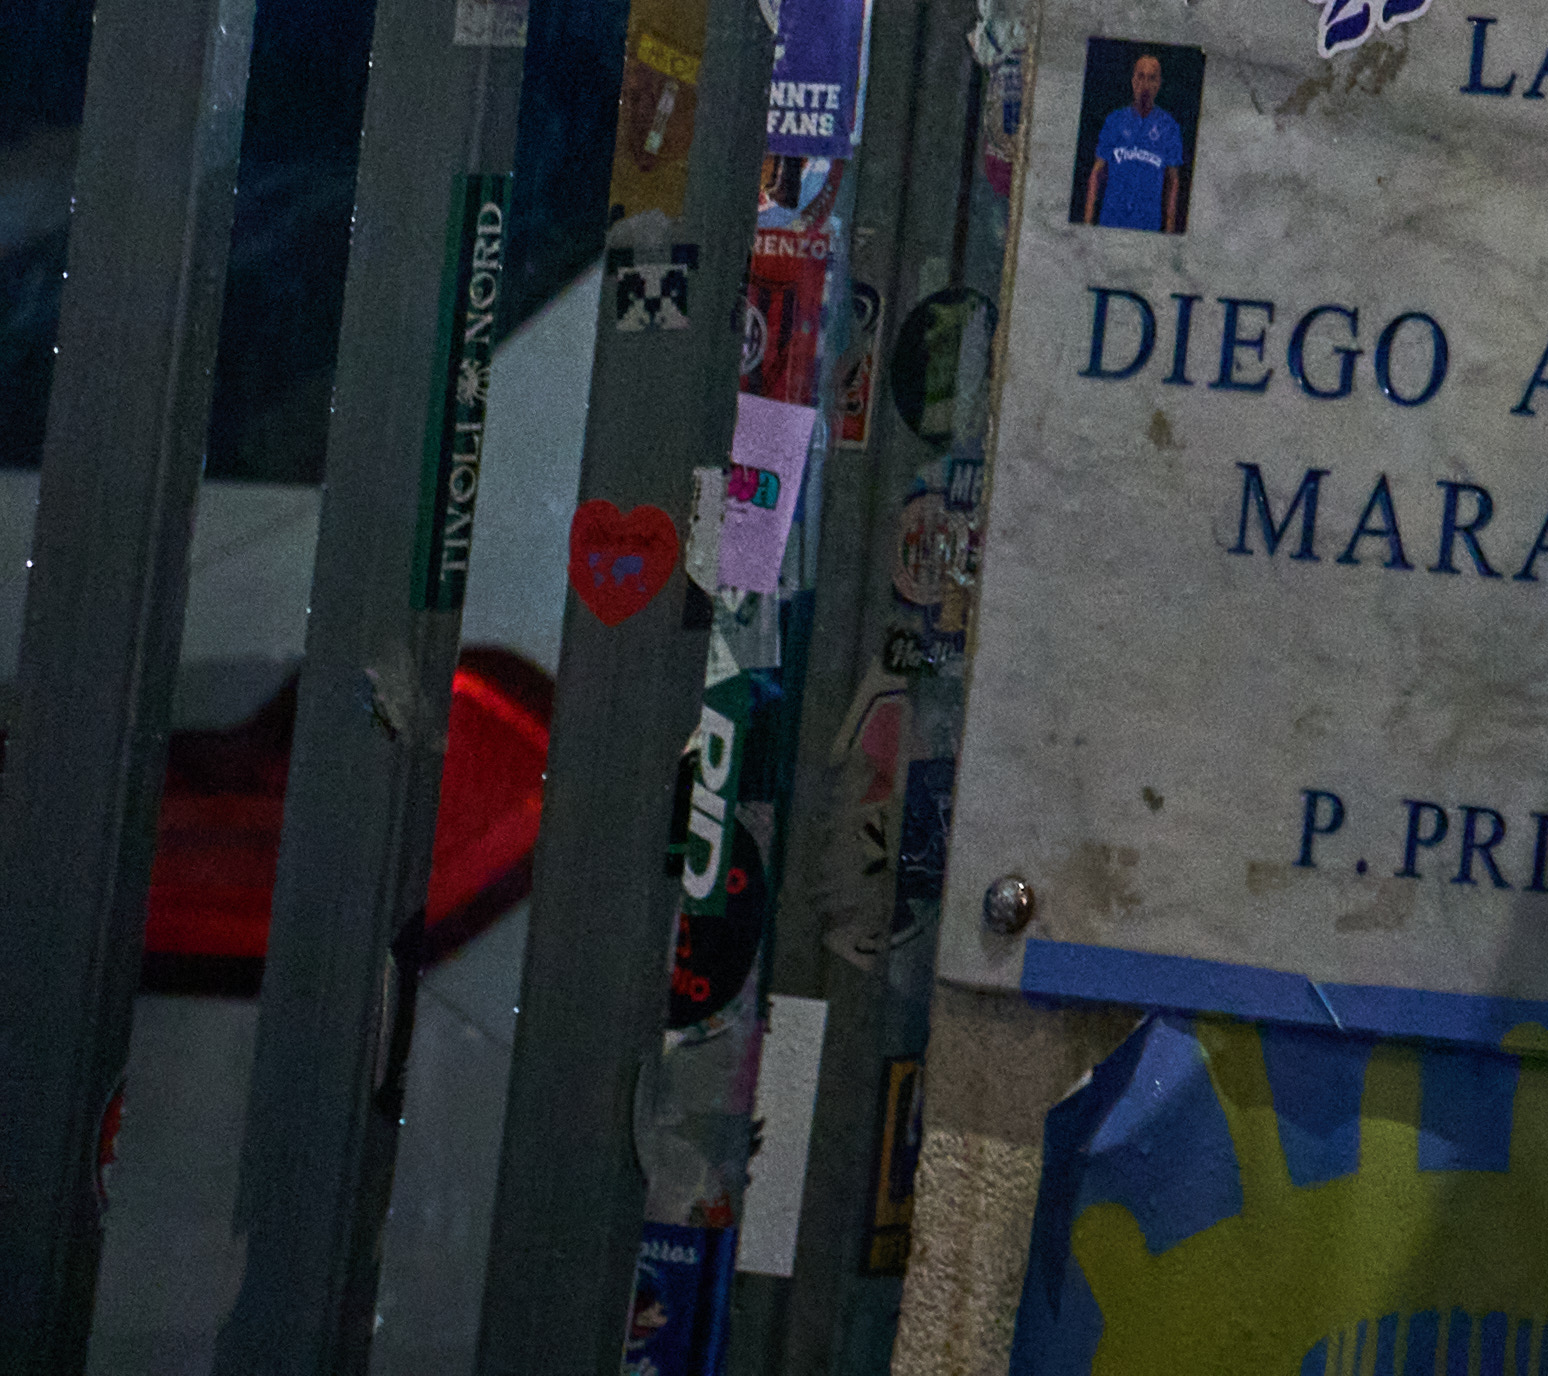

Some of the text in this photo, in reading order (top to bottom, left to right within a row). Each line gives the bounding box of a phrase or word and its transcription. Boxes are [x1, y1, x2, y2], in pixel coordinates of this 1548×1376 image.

[767, 109, 836, 137] FANS
[440, 200, 503, 582] TIVOLI NORD
[1078, 286, 1450, 408] DIEGO
